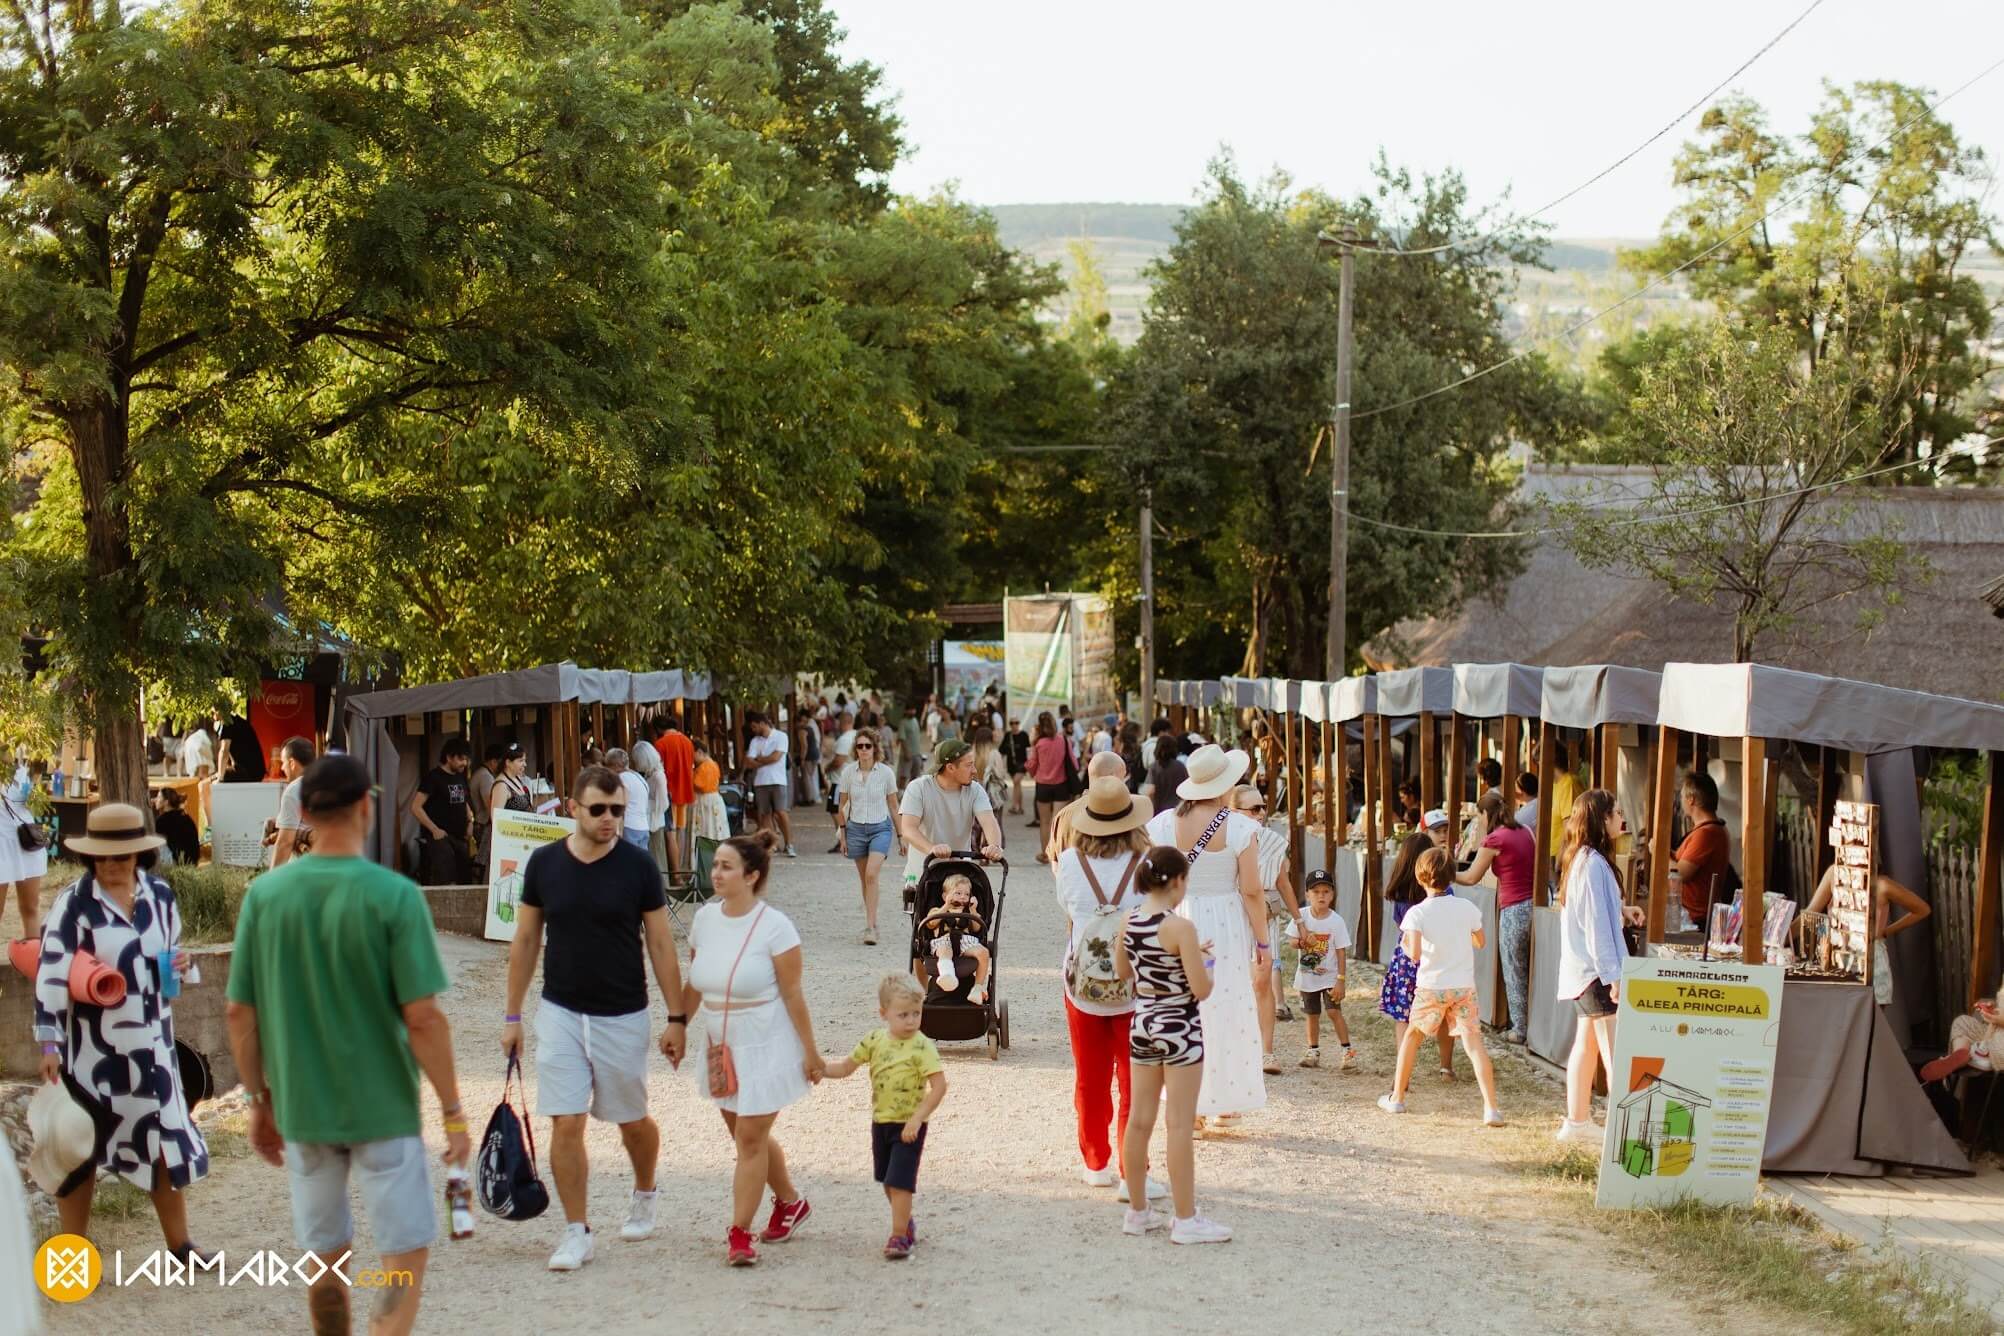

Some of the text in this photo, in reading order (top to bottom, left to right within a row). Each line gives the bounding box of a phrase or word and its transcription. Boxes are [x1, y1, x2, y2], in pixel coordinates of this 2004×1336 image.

[1197, 820, 1220, 848] PARIS
[1676, 985, 1725, 999] TÂRG:
[1636, 999, 1762, 1015] ALEEA PRINCIPALĂ
